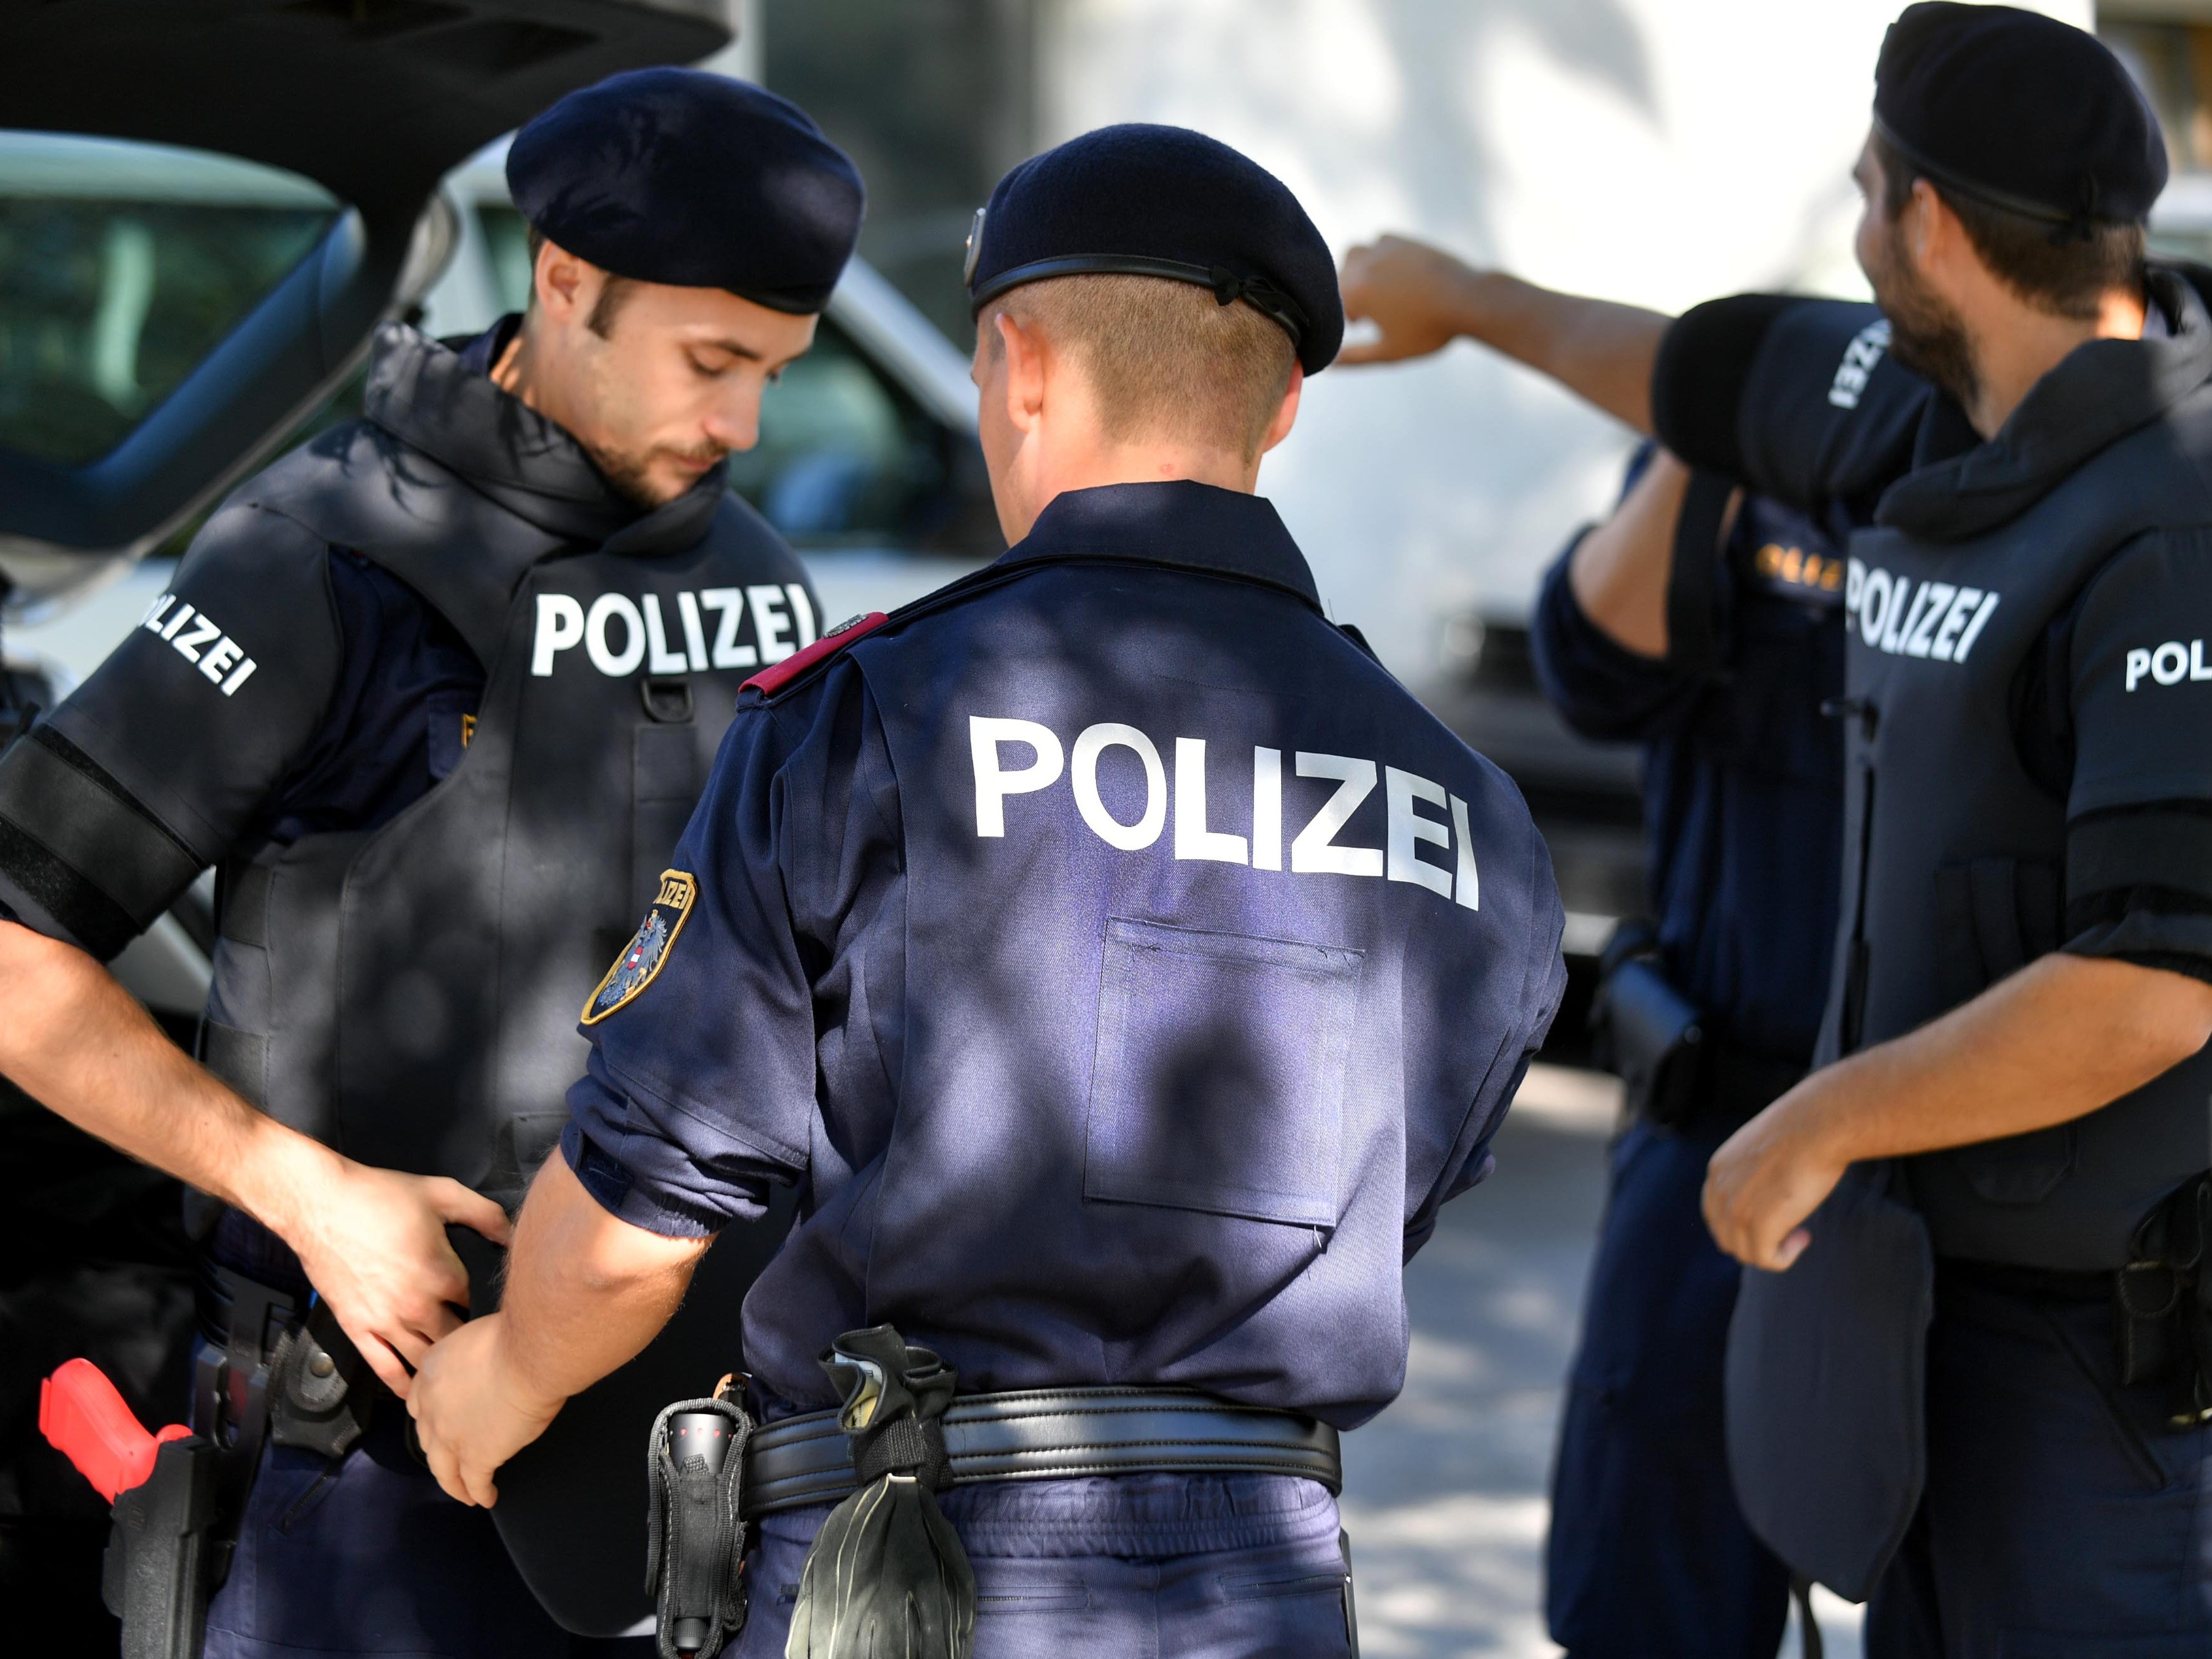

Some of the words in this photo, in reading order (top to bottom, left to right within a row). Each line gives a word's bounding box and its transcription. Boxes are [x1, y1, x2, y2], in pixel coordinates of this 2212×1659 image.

[141, 593, 257, 697] LIZEI
[531, 583, 816, 677] POLIZEI
[1845, 557, 2000, 664] POLIZEI
[969, 715, 1479, 911] POLIZEI
